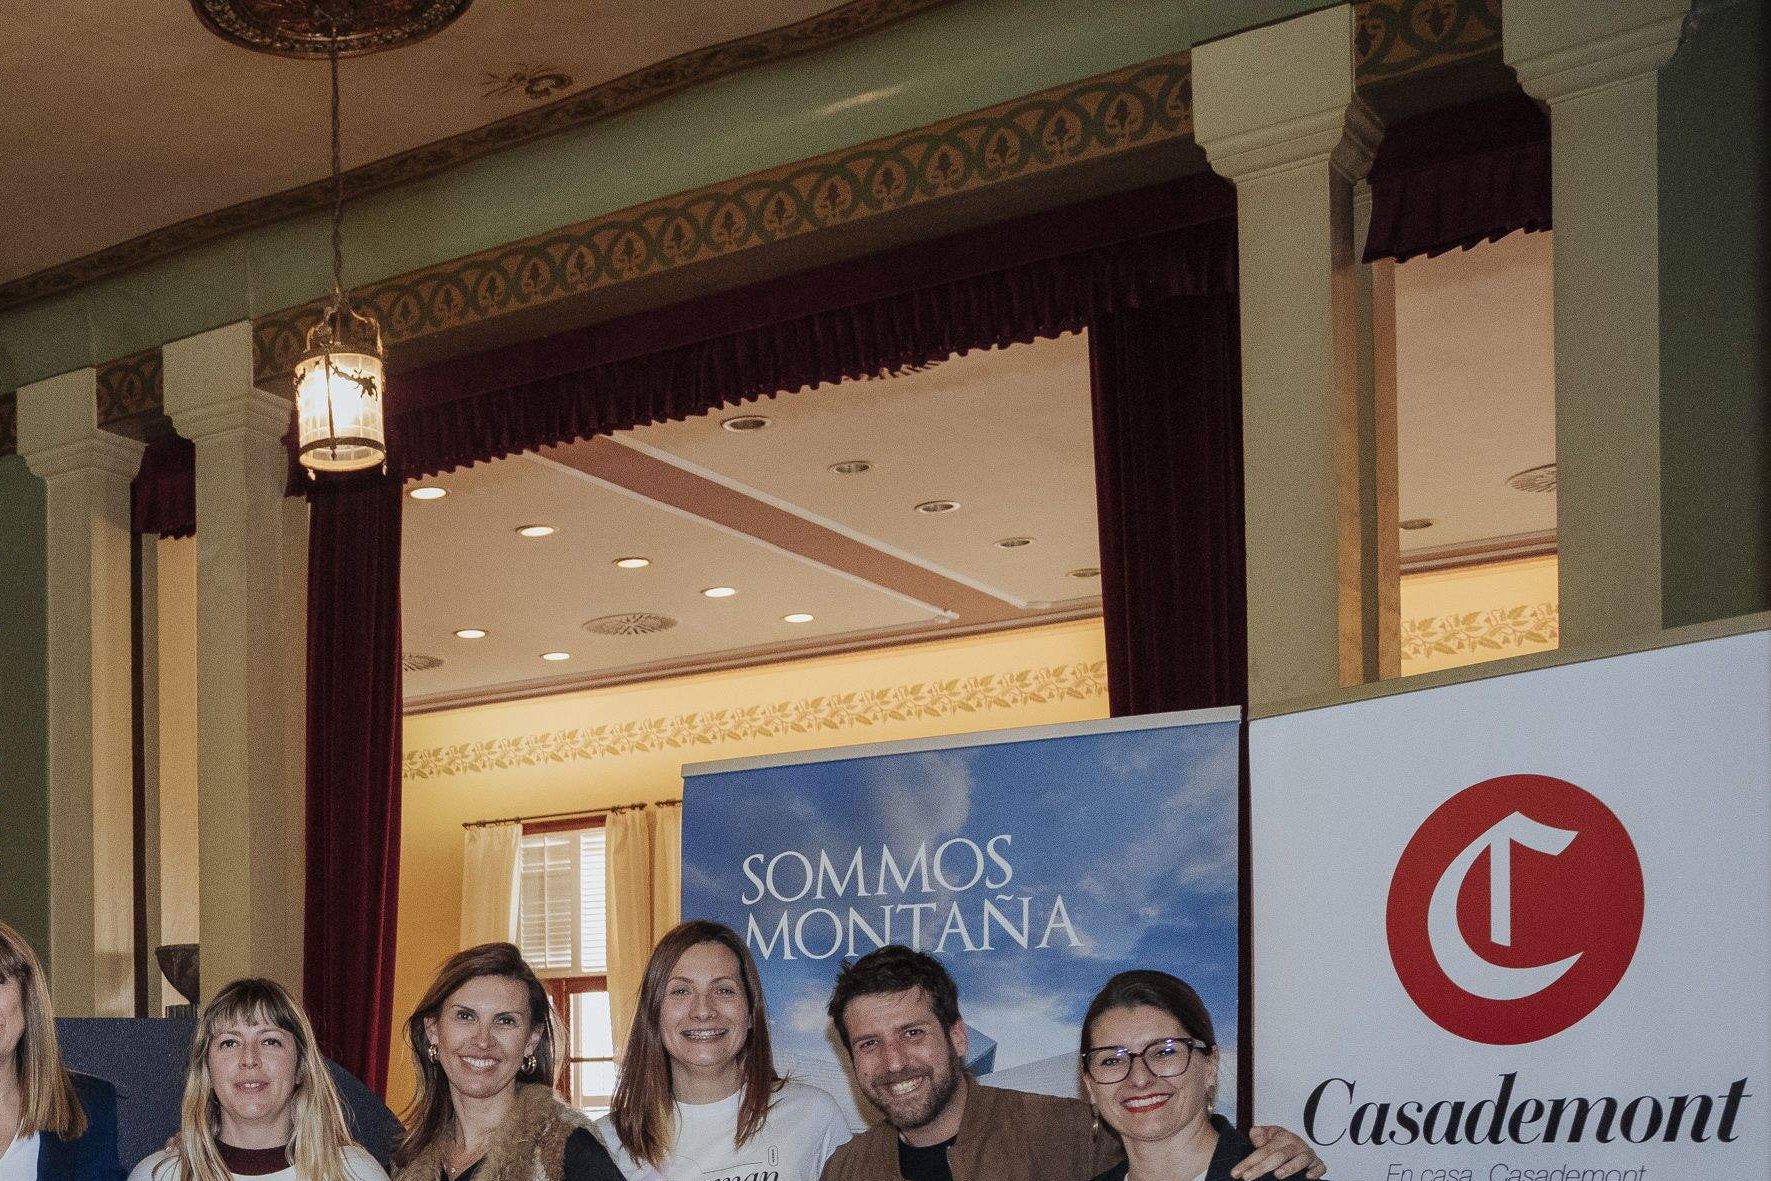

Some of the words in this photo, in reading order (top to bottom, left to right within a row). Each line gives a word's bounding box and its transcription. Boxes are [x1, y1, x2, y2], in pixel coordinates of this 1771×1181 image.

[741, 834, 1014, 905] SOMMOS
[746, 893, 1084, 960] MONTAÑA
[1303, 1070, 1753, 1147] Casademont
